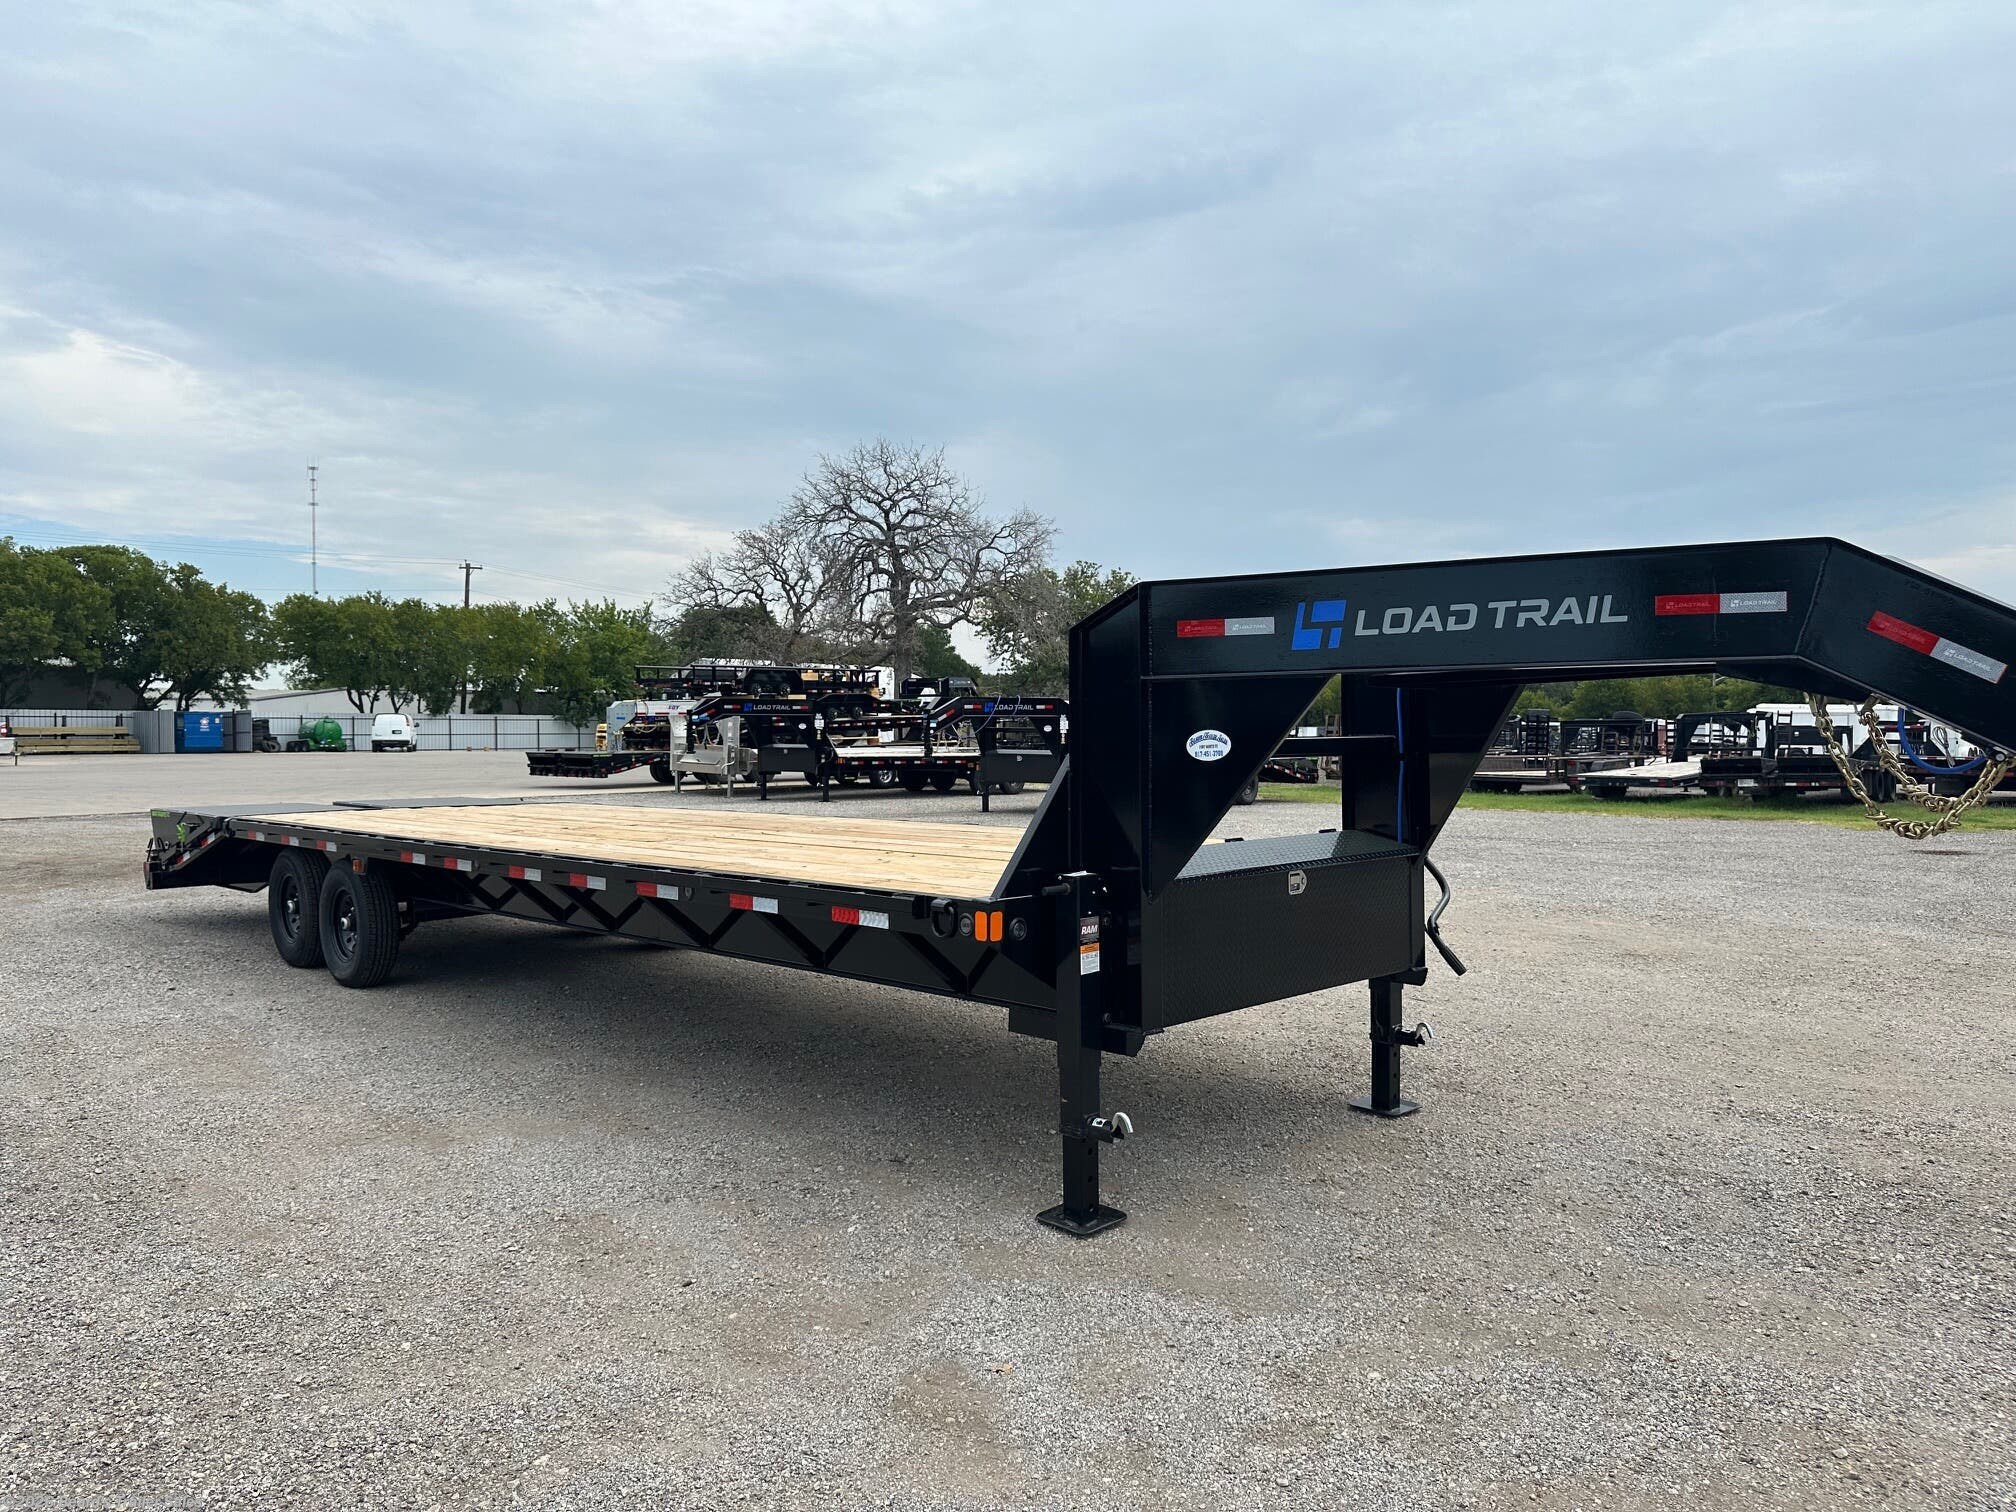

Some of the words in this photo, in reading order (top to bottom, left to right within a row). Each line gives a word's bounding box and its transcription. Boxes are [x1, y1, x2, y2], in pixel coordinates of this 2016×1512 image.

[1354, 603, 1478, 636] LOAD
[1488, 594, 1629, 629] TRAIL
[1081, 924, 1098, 935] RAM
